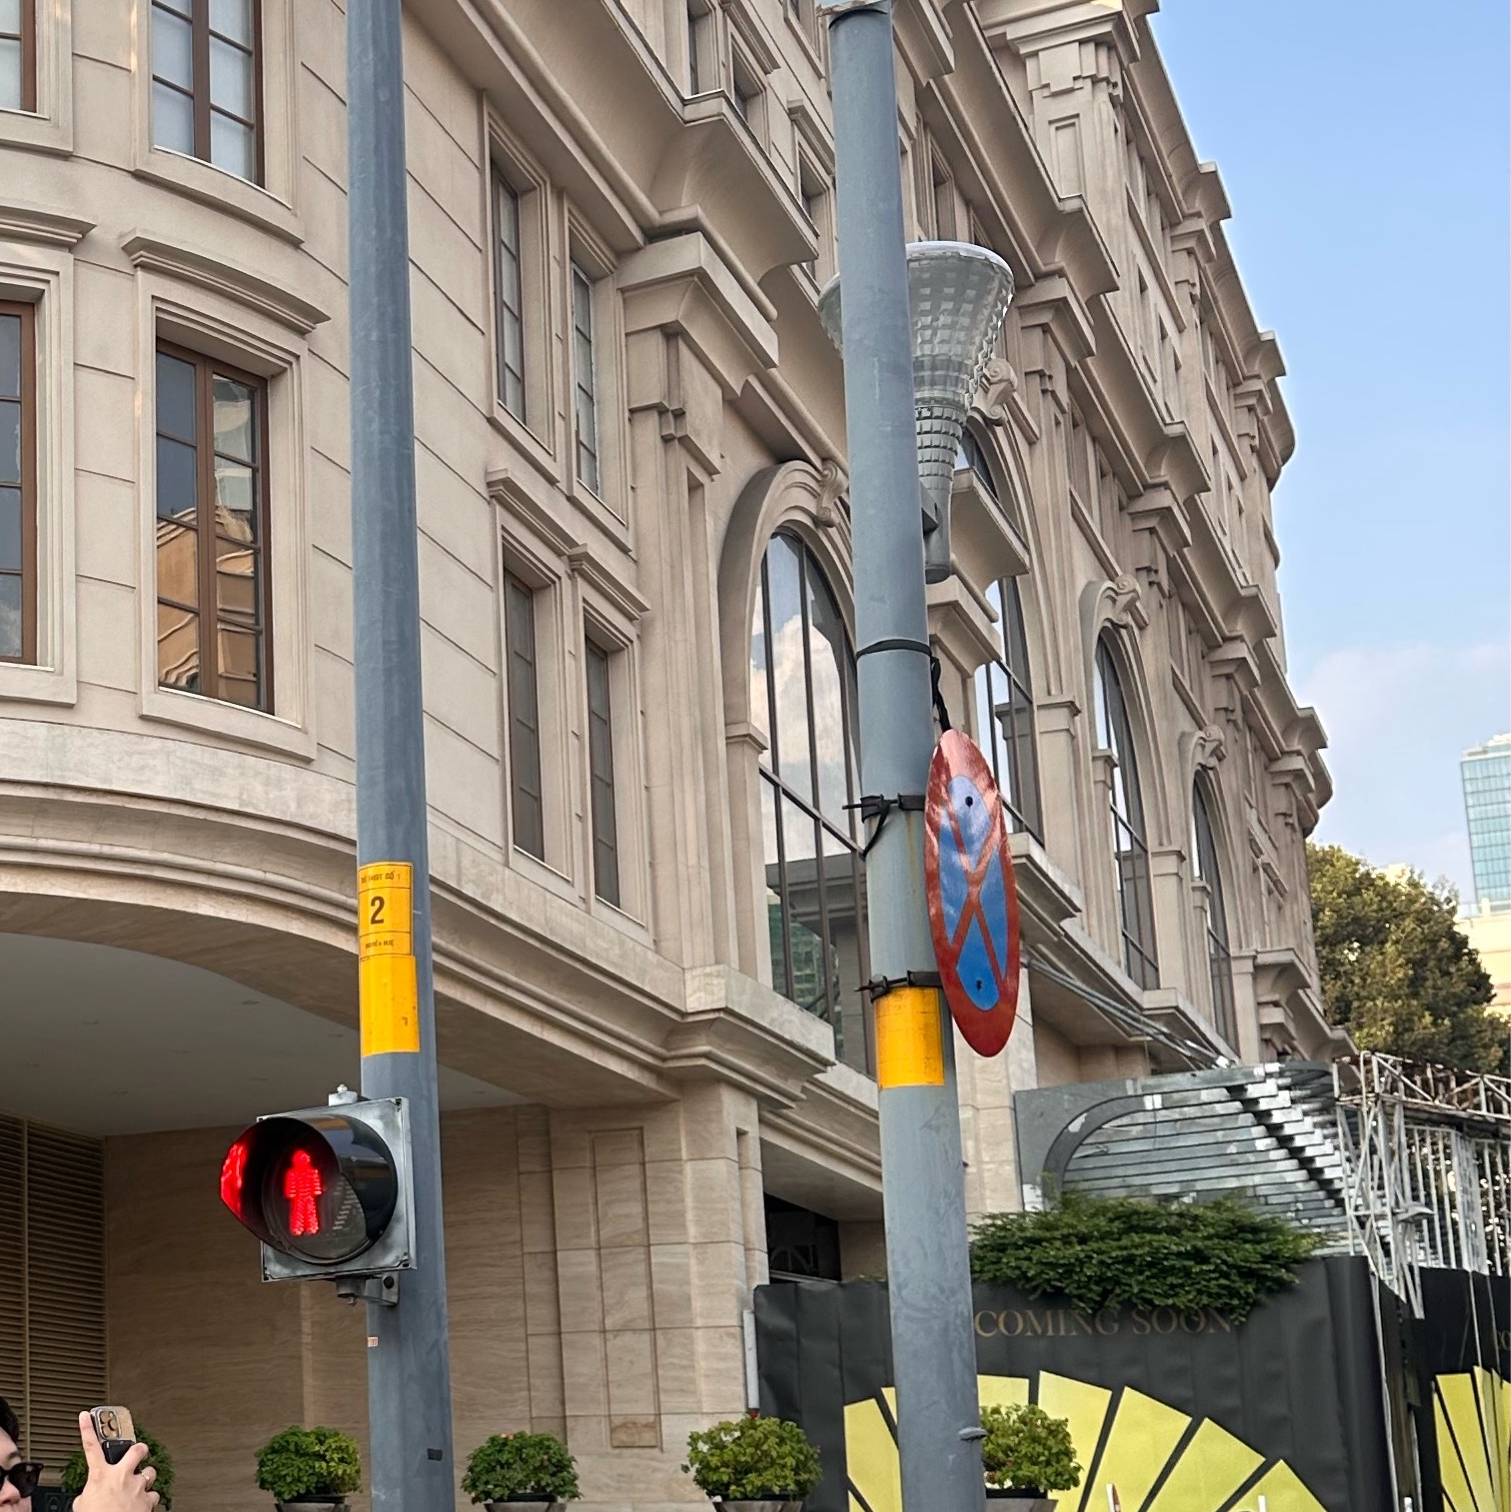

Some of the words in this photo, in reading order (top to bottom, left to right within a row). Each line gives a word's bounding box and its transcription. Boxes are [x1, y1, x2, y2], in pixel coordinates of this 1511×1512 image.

[370, 895, 385, 925] 2
[974, 1308, 1120, 1338] COMING
[1131, 1306, 1232, 1336] SOON
